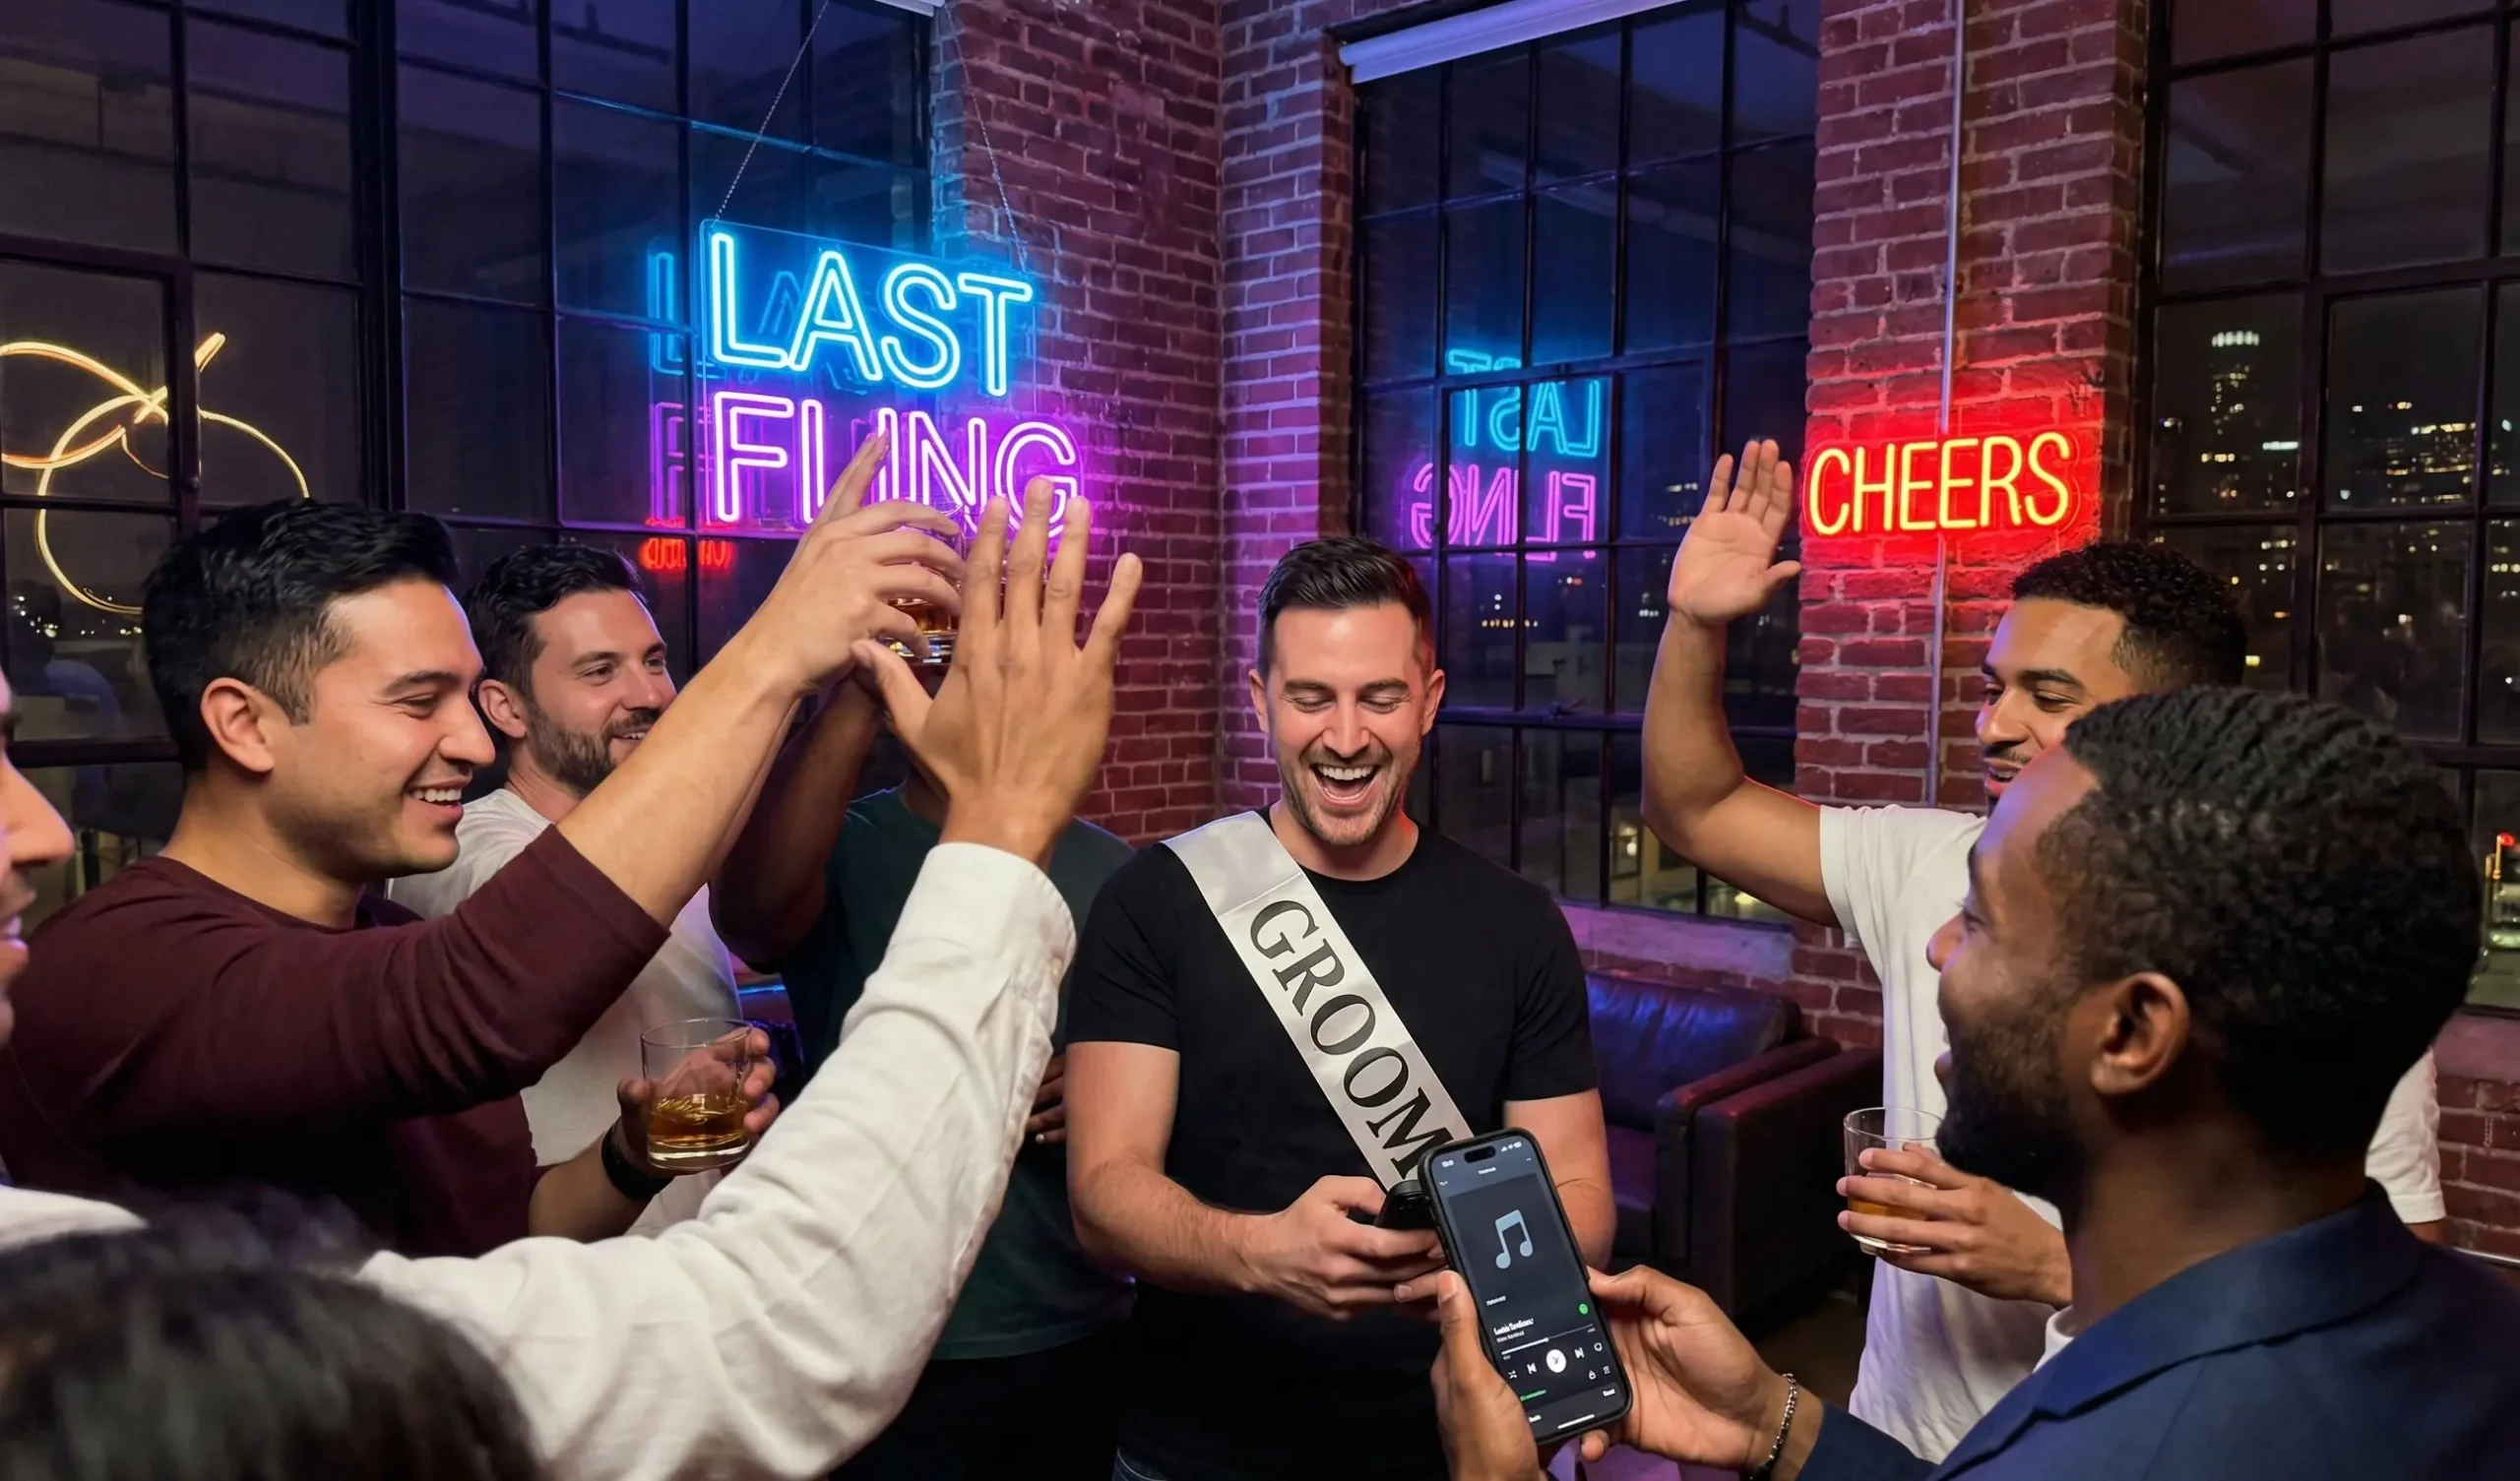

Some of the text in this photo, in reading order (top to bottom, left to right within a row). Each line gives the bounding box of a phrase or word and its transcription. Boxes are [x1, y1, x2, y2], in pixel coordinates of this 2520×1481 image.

[711, 232, 1034, 397] LAST
[1809, 432, 2070, 535] CHEERS
[1249, 899, 1454, 1180] GROOM
